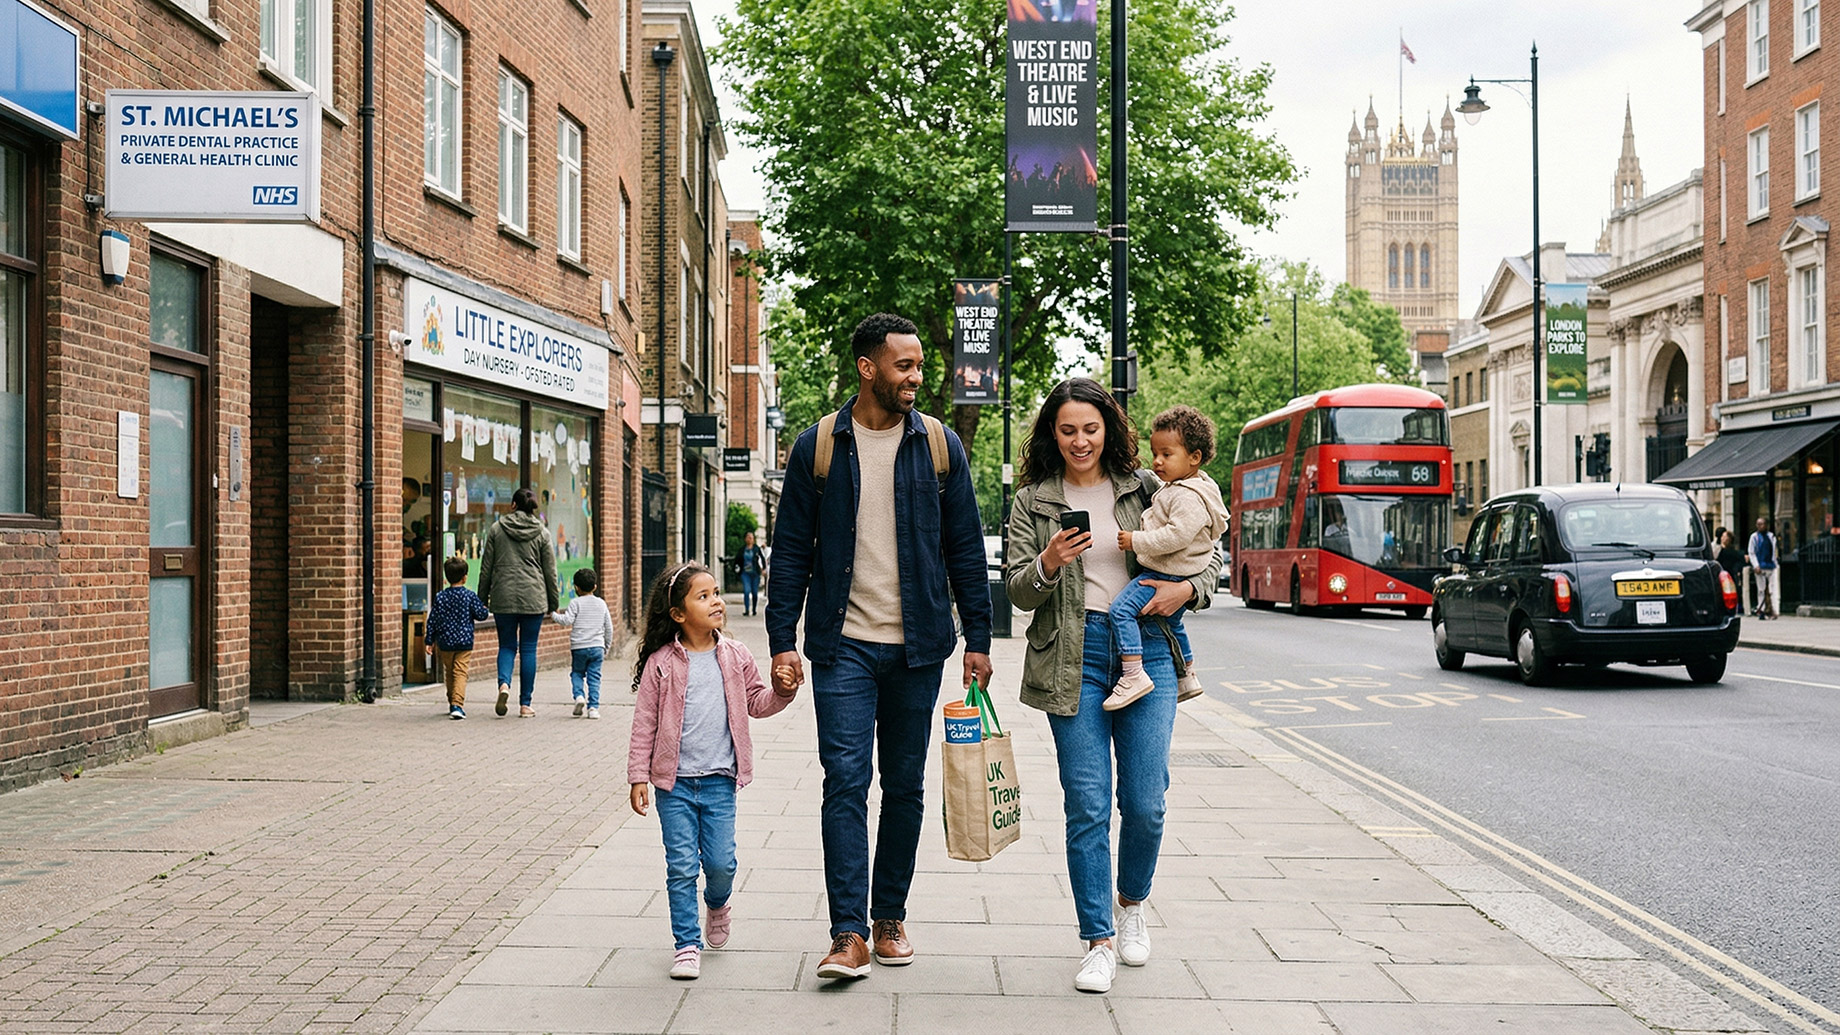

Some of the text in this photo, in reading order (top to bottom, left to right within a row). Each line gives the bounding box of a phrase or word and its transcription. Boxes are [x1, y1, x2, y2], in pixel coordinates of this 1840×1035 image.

[1012, 40, 1093, 60] WEST END
[1017, 62, 1088, 82] THEATRE
[1027, 85, 1077, 104] & LIVE
[121, 105, 299, 129] ST. MICHAEL'S
[1027, 107, 1078, 126] MUSIC
[121, 134, 299, 149] PRIVATE DENTAL PRACTICE
[121, 152, 299, 167] & GENERAL HEALTH CLINIC
[254, 187, 296, 204] NHS
[955, 306, 998, 318] WEST END
[958, 318, 995, 330] THEATRE
[1549, 320, 1582, 331] LONDON
[455, 305, 583, 373] LITTLE EXPLORERS
[963, 330, 990, 342] & LIVE
[1547, 331, 1586, 343] PARKS TO
[963, 342, 990, 354] MUSIC
[1548, 343, 1584, 354] EXPLORE
[463, 348, 481, 367] DAY
[482, 355, 520, 377] NURSERY
[525, 365, 553, 386] OFSTED
[553, 372, 576, 393] RATED
[1411, 465, 1429, 482] 68
[1219, 676, 1391, 694] BUS
[1249, 691, 1479, 714] STOP
[986, 760, 1005, 782] UK
